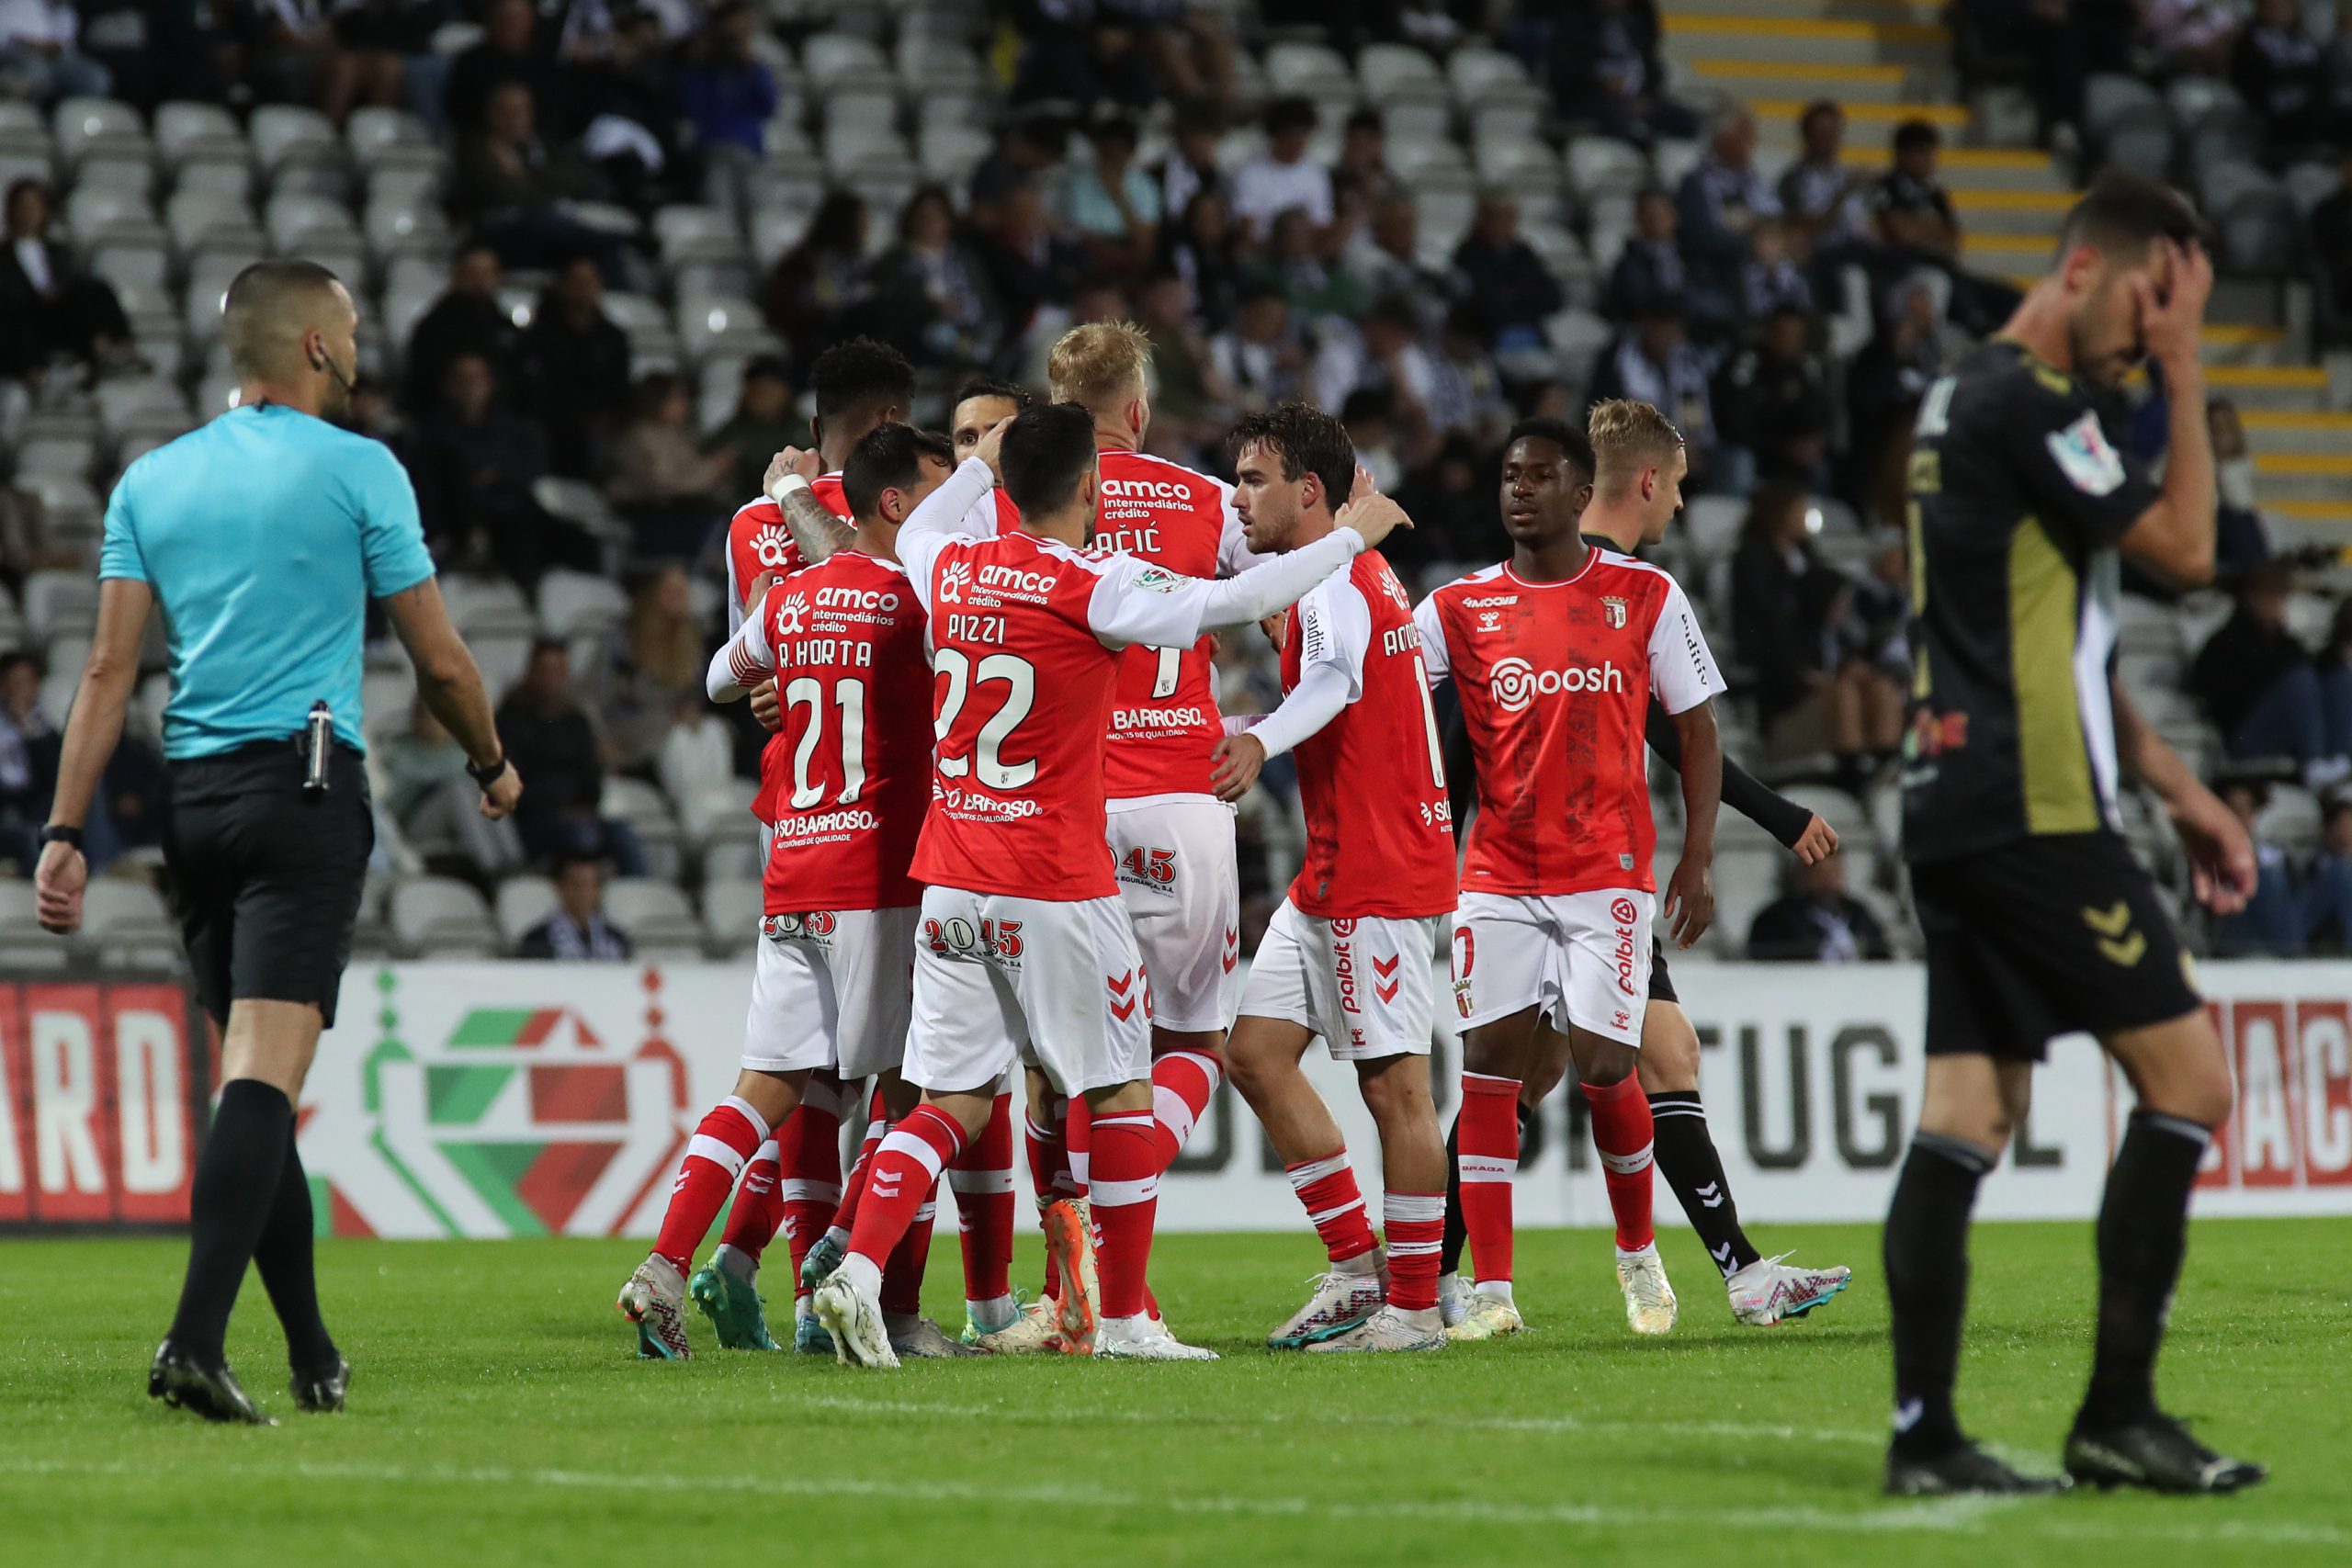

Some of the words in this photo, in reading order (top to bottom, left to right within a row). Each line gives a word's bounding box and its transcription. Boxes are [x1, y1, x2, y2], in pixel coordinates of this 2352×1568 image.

[1101, 479, 1191, 501] amco
[1103, 498, 1194, 513] intermediários
[1104, 509, 1150, 520] crédito
[1083, 521, 1161, 553] AČIĆ
[971, 582, 1048, 604] intermediários
[978, 565, 1057, 593] amco
[816, 587, 899, 612] amco
[967, 595, 1001, 608] crédito
[810, 621, 847, 633] crédito
[812, 609, 895, 626] intermediários
[947, 614, 1005, 644] PIZZI
[1307, 611, 1325, 661] auditiv
[1680, 614, 1709, 686] auditiv
[933, 647, 1037, 790] 22
[786, 677, 866, 810] 21
[806, 837, 815, 845] DE
[814, 833, 851, 844] QUALIDADE
[1108, 845, 1177, 885] 45
[924, 918, 1024, 959] 2045
[1614, 924, 1635, 996] palbit
[1333, 940, 1362, 1014] palbit
